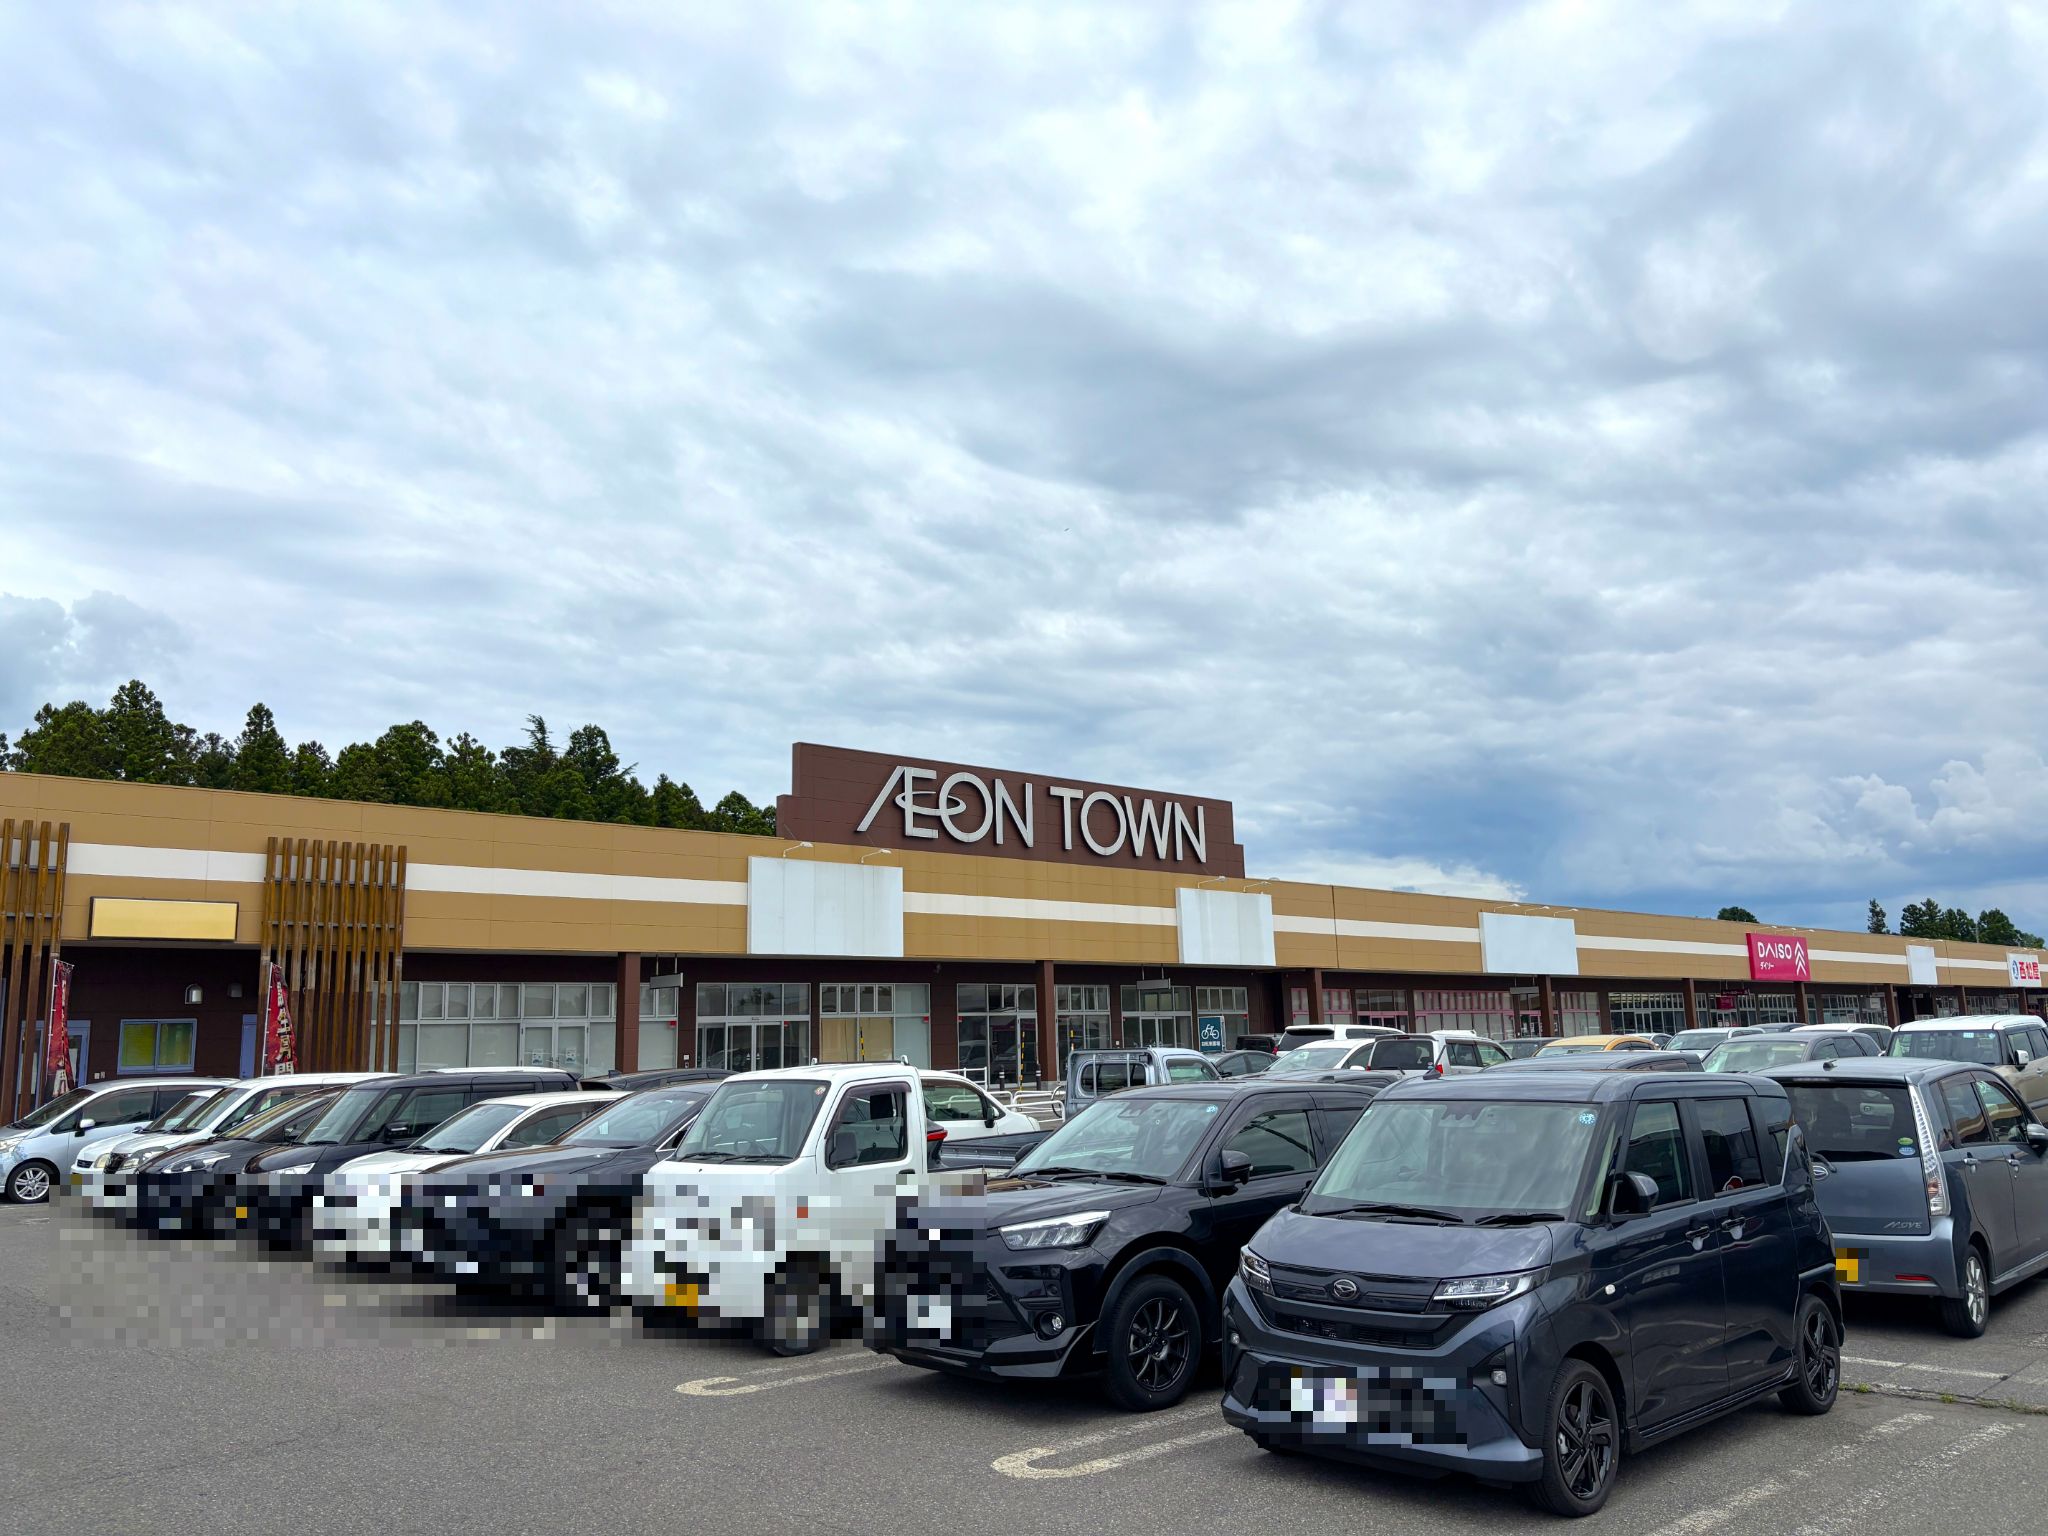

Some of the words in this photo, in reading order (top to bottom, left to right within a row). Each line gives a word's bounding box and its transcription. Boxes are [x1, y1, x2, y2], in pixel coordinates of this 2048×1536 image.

[1049, 786, 1206, 863] TOWN
[1757, 941, 1792, 960] DAISO
[1883, 1221, 1922, 1230] MOVE
